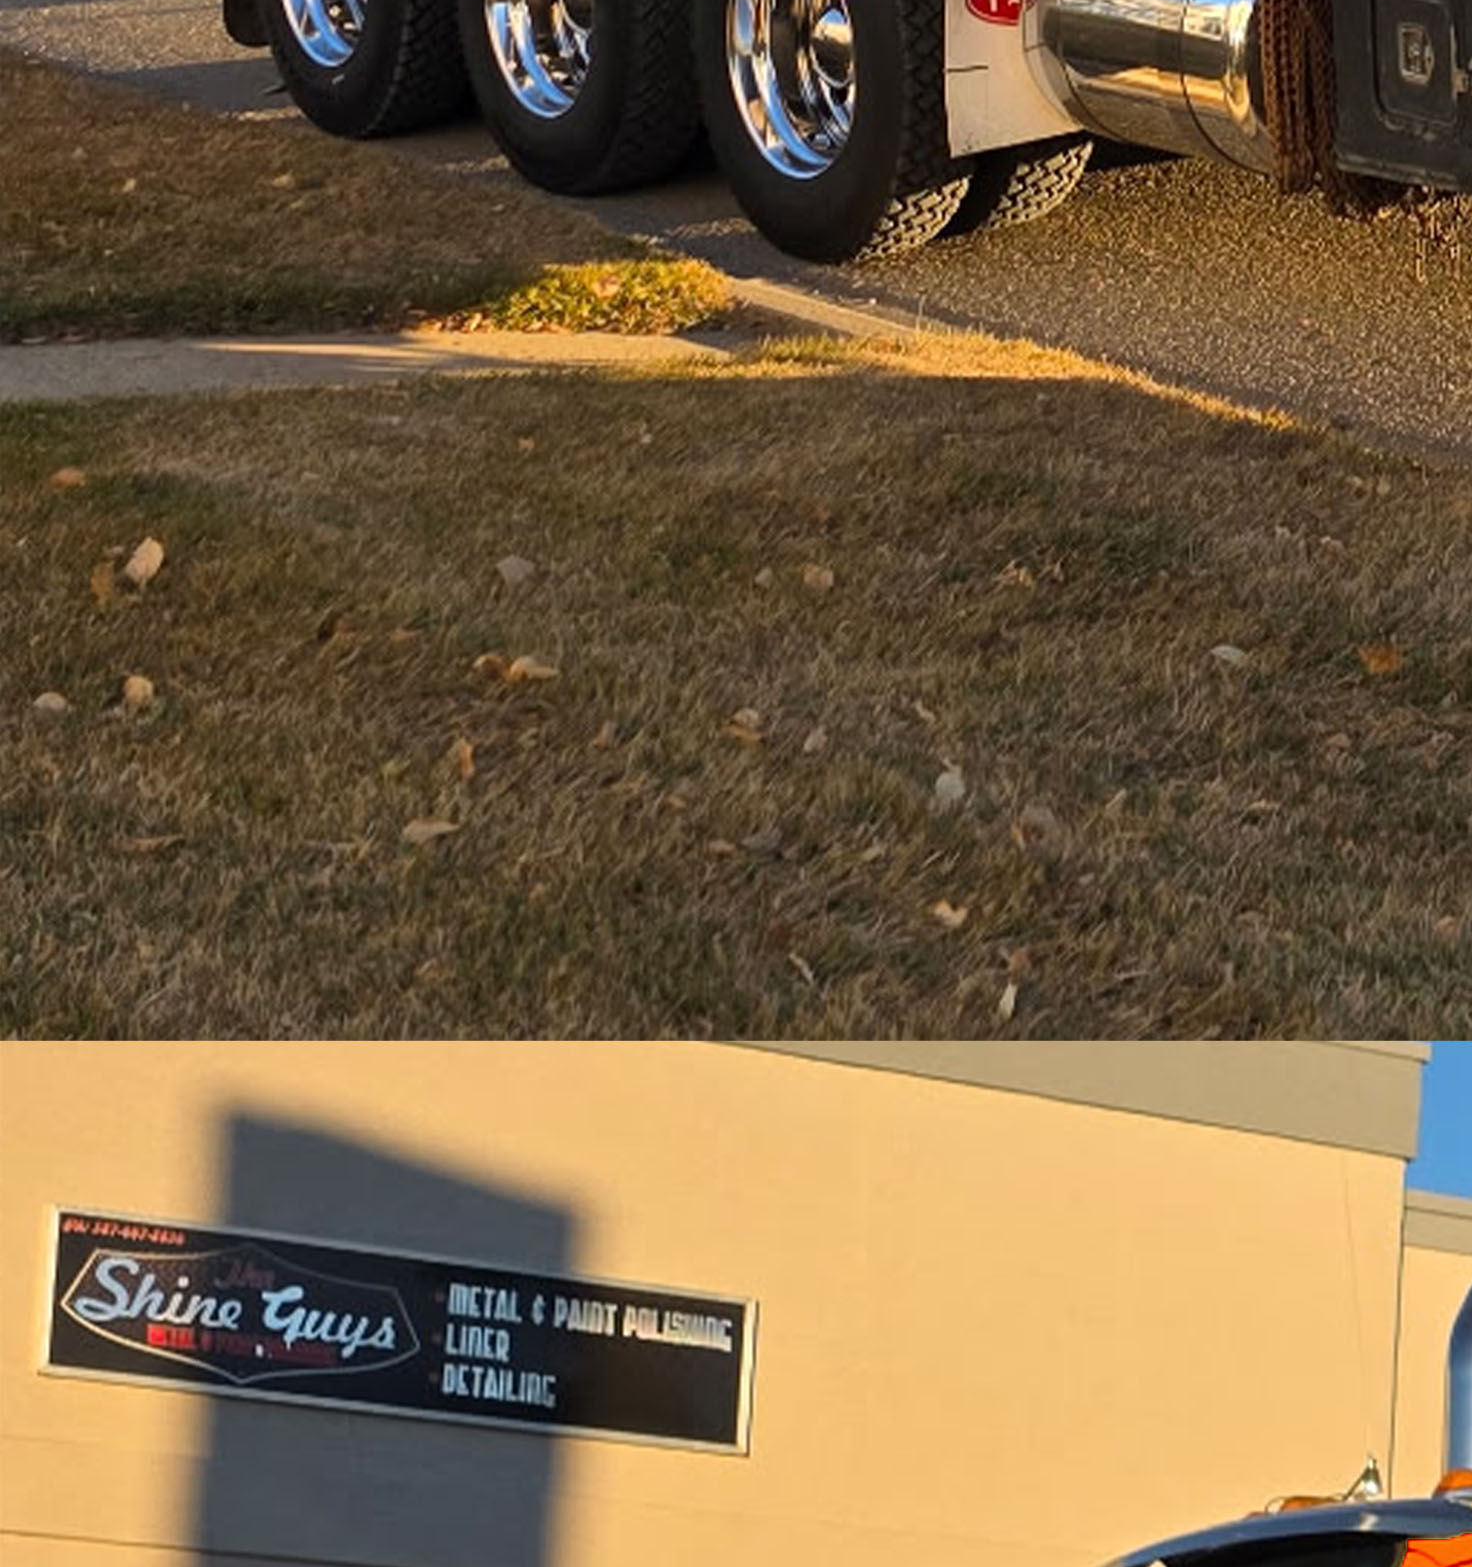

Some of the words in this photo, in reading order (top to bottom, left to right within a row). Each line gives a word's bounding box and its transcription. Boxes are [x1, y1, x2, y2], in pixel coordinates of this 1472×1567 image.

[74, 1258, 242, 1329] Shine
[262, 1287, 396, 1358] Guys
[449, 1282, 522, 1323] METAL
[442, 1363, 556, 1408] DETAILING
